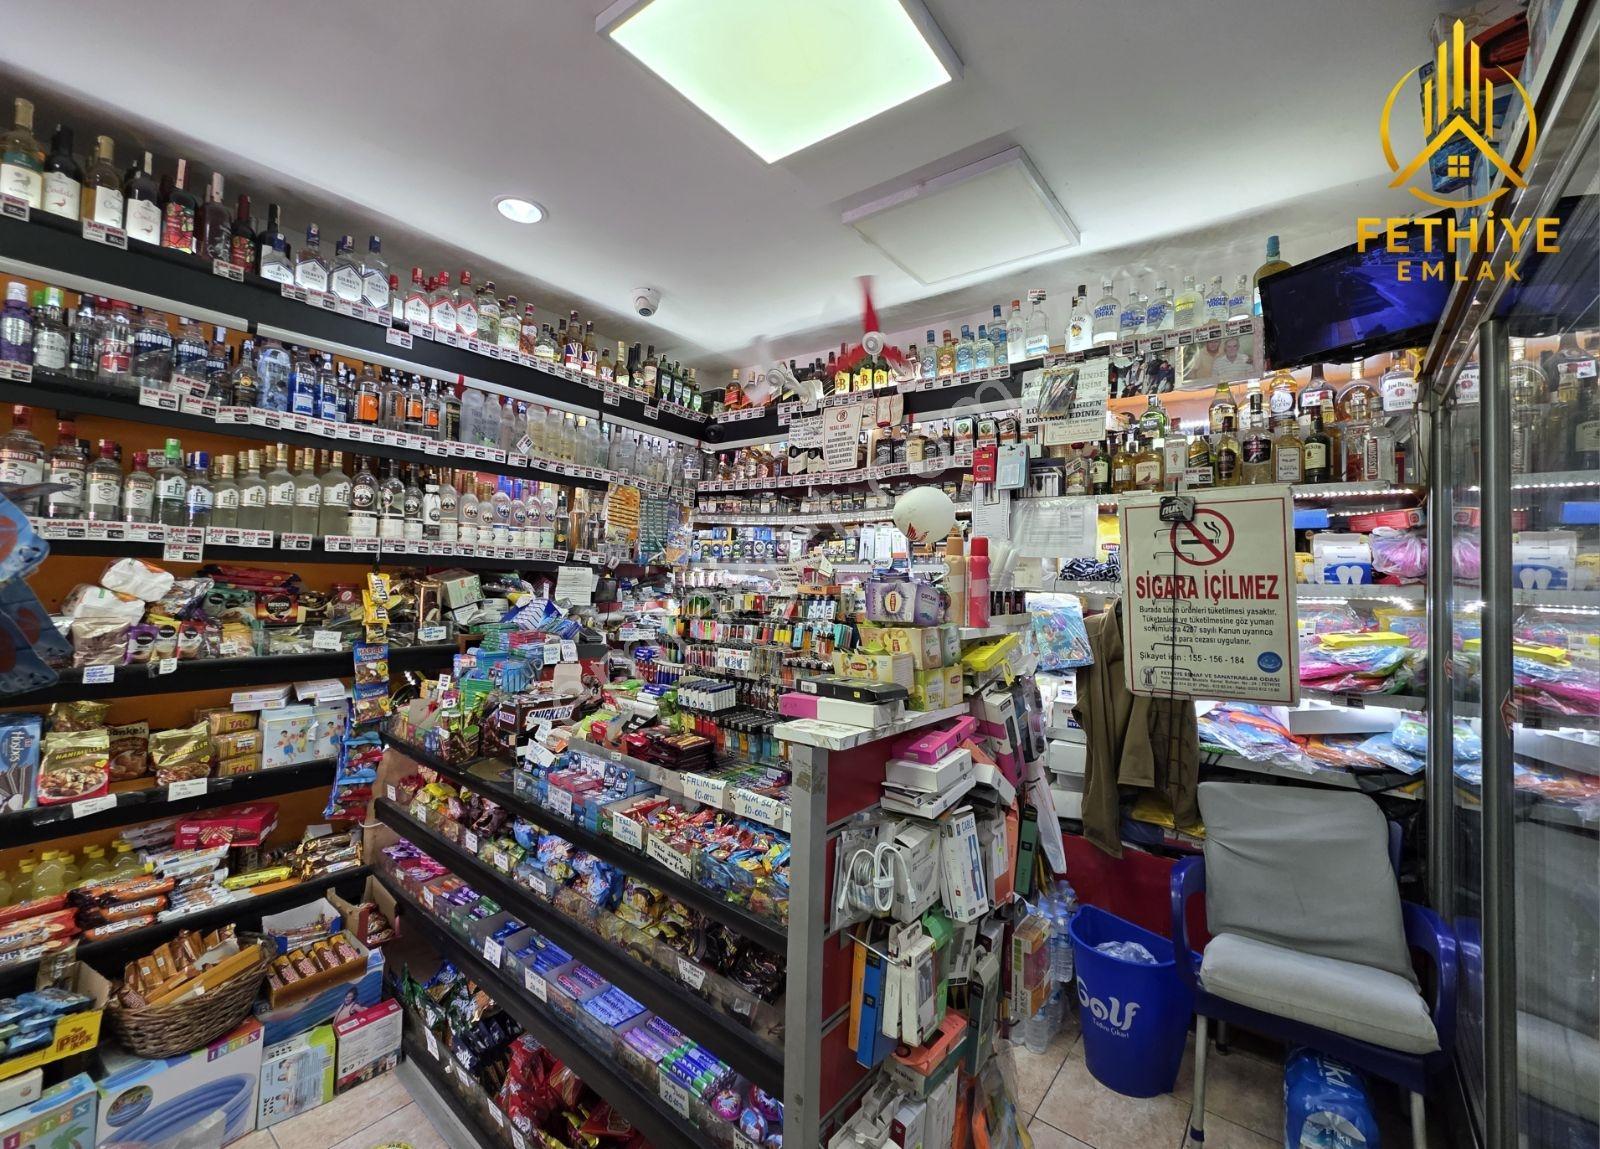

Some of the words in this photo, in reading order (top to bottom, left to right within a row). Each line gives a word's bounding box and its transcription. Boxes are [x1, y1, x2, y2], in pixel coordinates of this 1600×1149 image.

[1136, 570, 1199, 600] SİGARA
[1204, 569, 1280, 606] İÇİLMEZ
[1139, 605, 1161, 614] Burada
[1207, 607, 1245, 615] tüketilmesi
[1189, 616, 1234, 624] tüketilmesine
[1235, 617, 1248, 626] göz
[1250, 619, 1274, 627] yuman
[1199, 626, 1217, 635] sayılı
[1218, 627, 1241, 635] Kanun
[1242, 628, 1273, 638] uyarınca
[1178, 636, 1194, 645] para
[1194, 636, 1216, 645] cezası
[1139, 652, 1167, 662] Şikayet
[1189, 654, 1203, 662] 155
[1209, 655, 1223, 663] 156
[1230, 656, 1245, 664] 184
[529, 706, 574, 721] SNICKERS
[1076, 975, 1141, 1031] Golf
[209, 1031, 261, 1061] INTEX
[6, 1102, 89, 1146] INTEX
